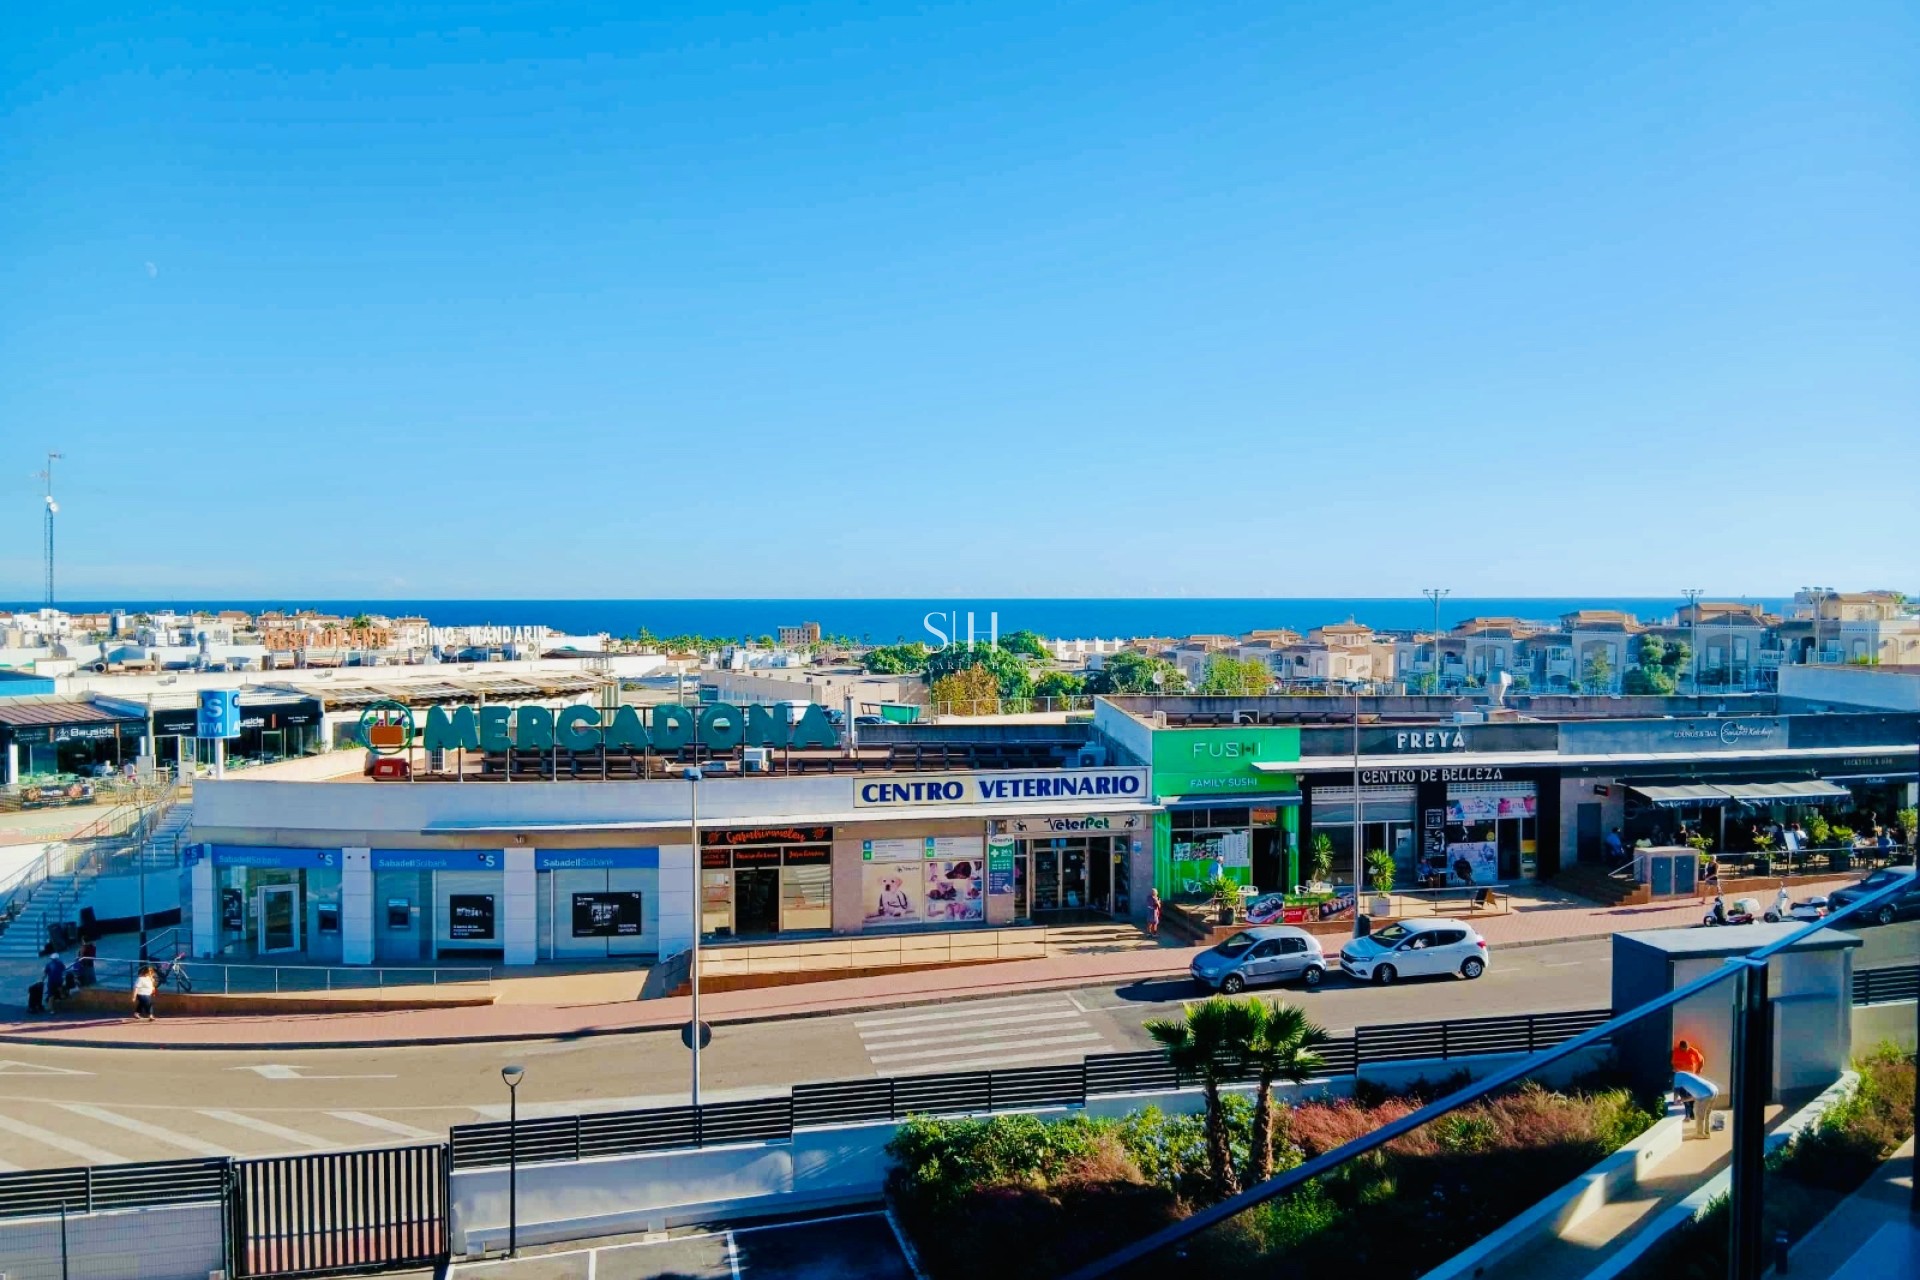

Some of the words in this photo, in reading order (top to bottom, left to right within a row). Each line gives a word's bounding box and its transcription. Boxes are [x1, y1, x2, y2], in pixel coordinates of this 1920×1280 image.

[265, 627, 394, 651] RESTAURANTE
[406, 626, 455, 646] CHINO
[467, 624, 548, 645] MANDARIN
[206, 697, 223, 718] S
[70, 726, 115, 738] Bayside
[423, 703, 836, 752] MERCADONA
[1397, 731, 1465, 749] FREYA
[1190, 778, 1225, 789] FAMILY
[1228, 777, 1257, 787] SUSHI
[1362, 769, 1416, 784] CENTRO
[1420, 769, 1438, 782] DE
[1442, 767, 1503, 781] BELLEZA
[861, 780, 964, 803] CENTRO
[978, 775, 1141, 799] VETERINARIO
[1044, 817, 1110, 832] VeterPet
[485, 855, 496, 867] S
